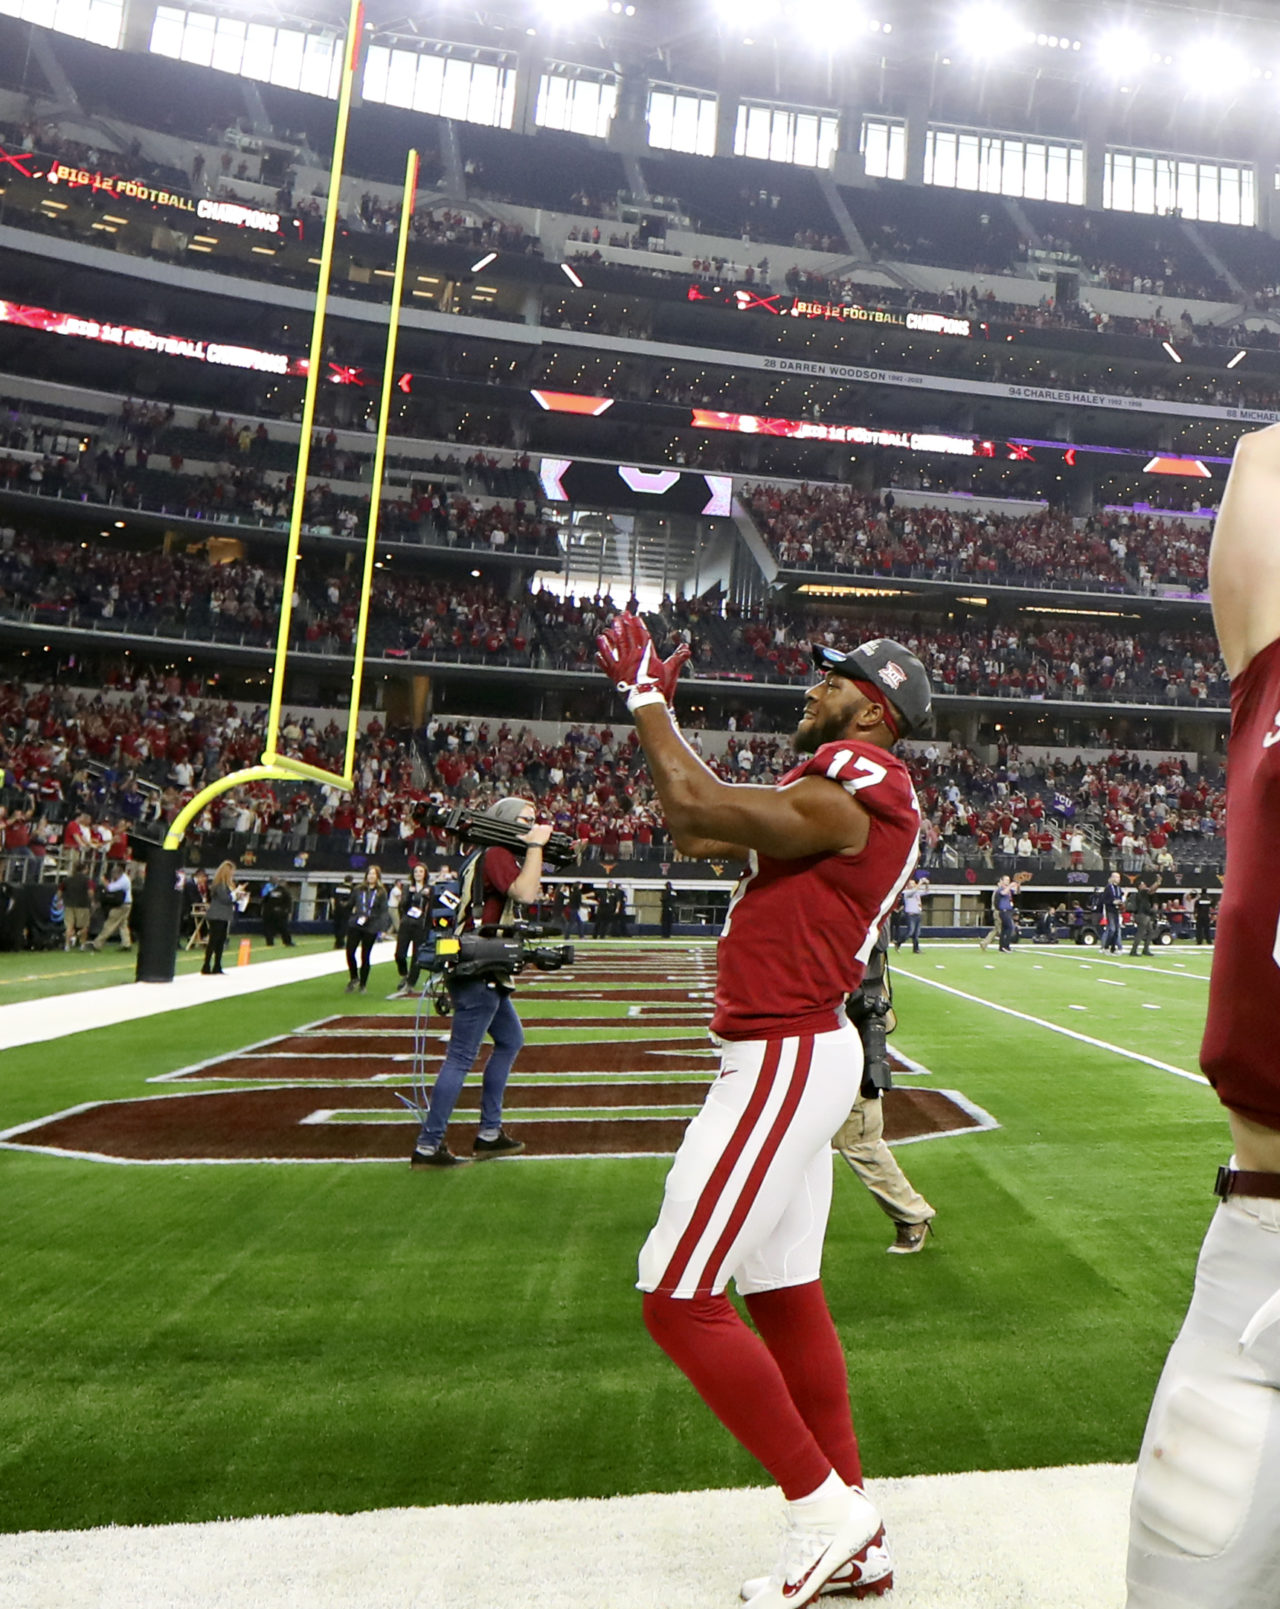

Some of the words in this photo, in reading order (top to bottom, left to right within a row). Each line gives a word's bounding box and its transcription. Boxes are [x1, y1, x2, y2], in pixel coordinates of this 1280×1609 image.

[57, 165, 90, 184] BIG
[95, 176, 113, 190] 12
[116, 182, 196, 212] FOOTBALL
[197, 199, 281, 233] CHAMPIONS
[797, 301, 822, 315] BIG
[824, 304, 841, 317] 12
[842, 307, 905, 326] FOOTBALL
[906, 313, 970, 336] CHAMPIONS
[763, 358, 777, 368] 28
[779, 360, 826, 375] DARREN
[829, 365, 886, 381] WOODSON
[1008, 387, 1021, 396] 94
[1023, 388, 1071, 401] CHARLES
[1072, 393, 1105, 405] HALEY
[826, 749, 887, 796] 17
